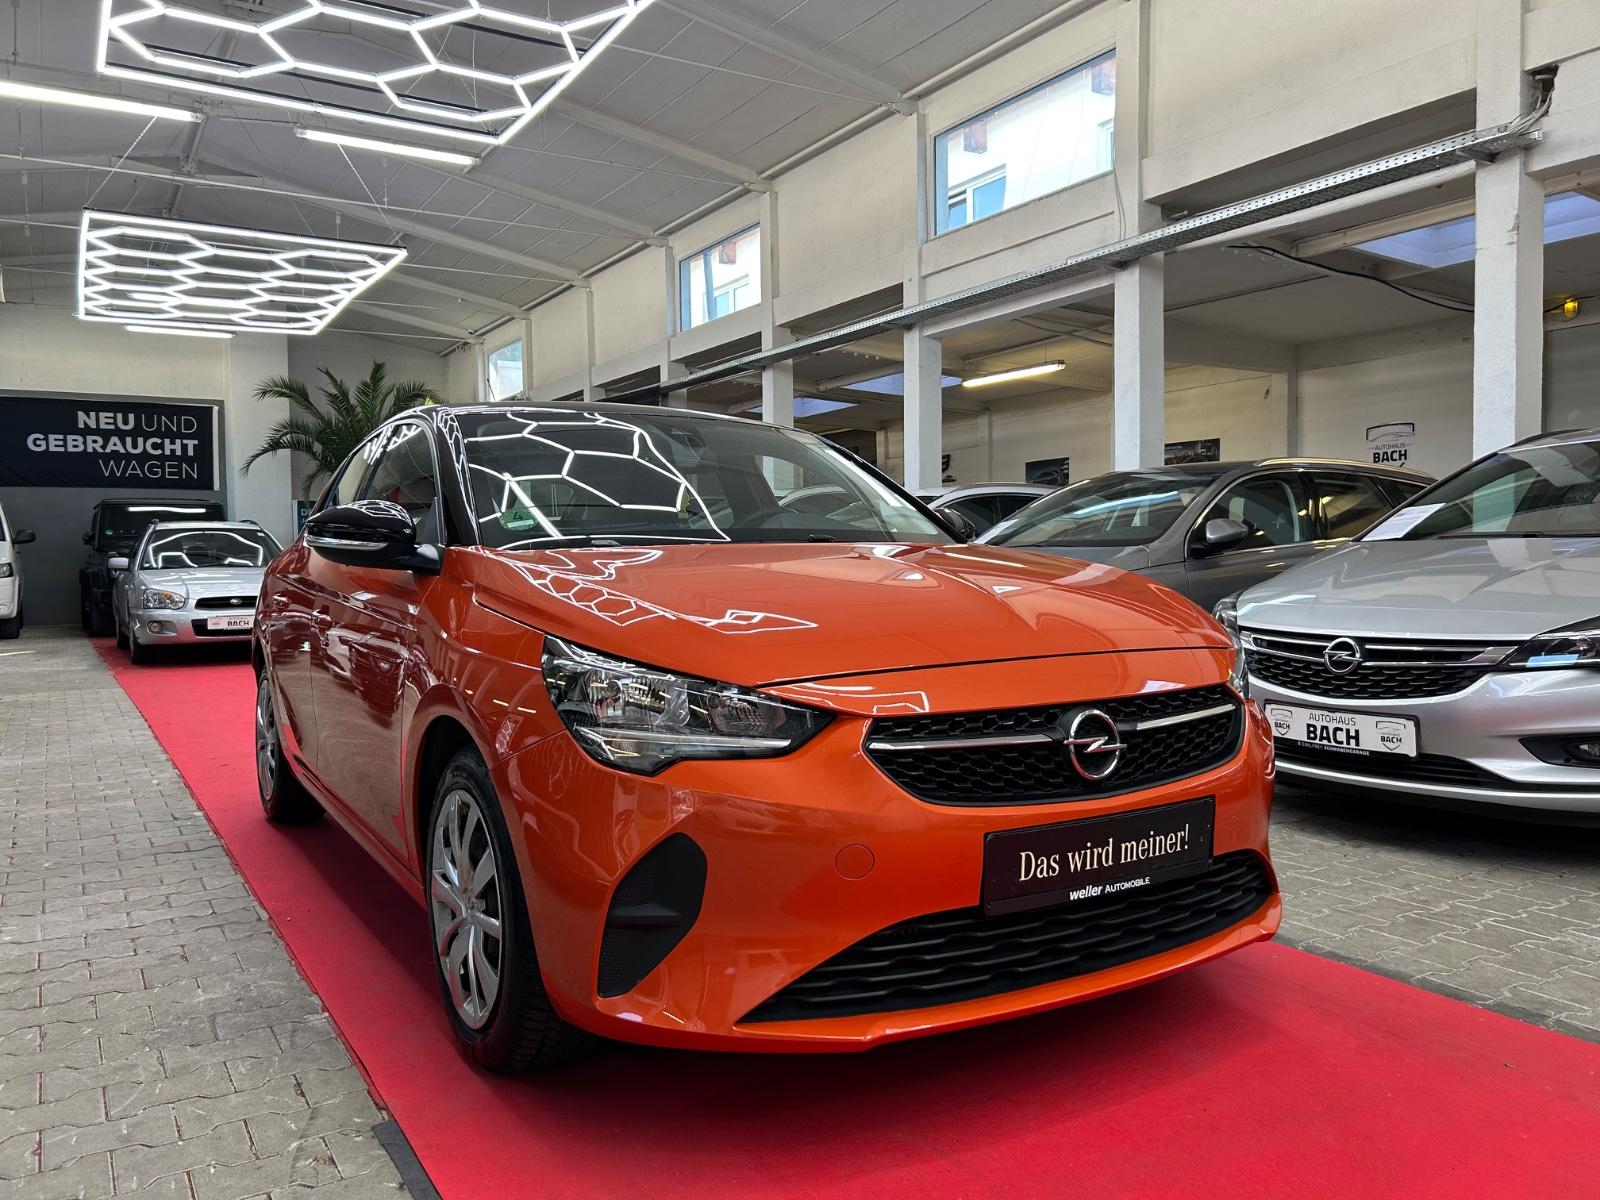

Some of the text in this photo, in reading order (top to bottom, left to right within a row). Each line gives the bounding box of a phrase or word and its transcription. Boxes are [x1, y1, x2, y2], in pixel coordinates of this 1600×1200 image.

[77, 411, 197, 432] NEU UND
[26, 433, 198, 456] GEBRAUCHT
[1375, 442, 1405, 450] AUTOHAUS
[1373, 449, 1407, 463] BACH
[99, 459, 198, 479] WAGEN
[1308, 712, 1356, 726] AUTOHAUS
[1306, 722, 1360, 747] BACH
[1380, 735, 1402, 744] BACH
[1018, 823, 1190, 882] Das wird meiner!
[1069, 876, 1151, 901] weller AUTOMOBILE
